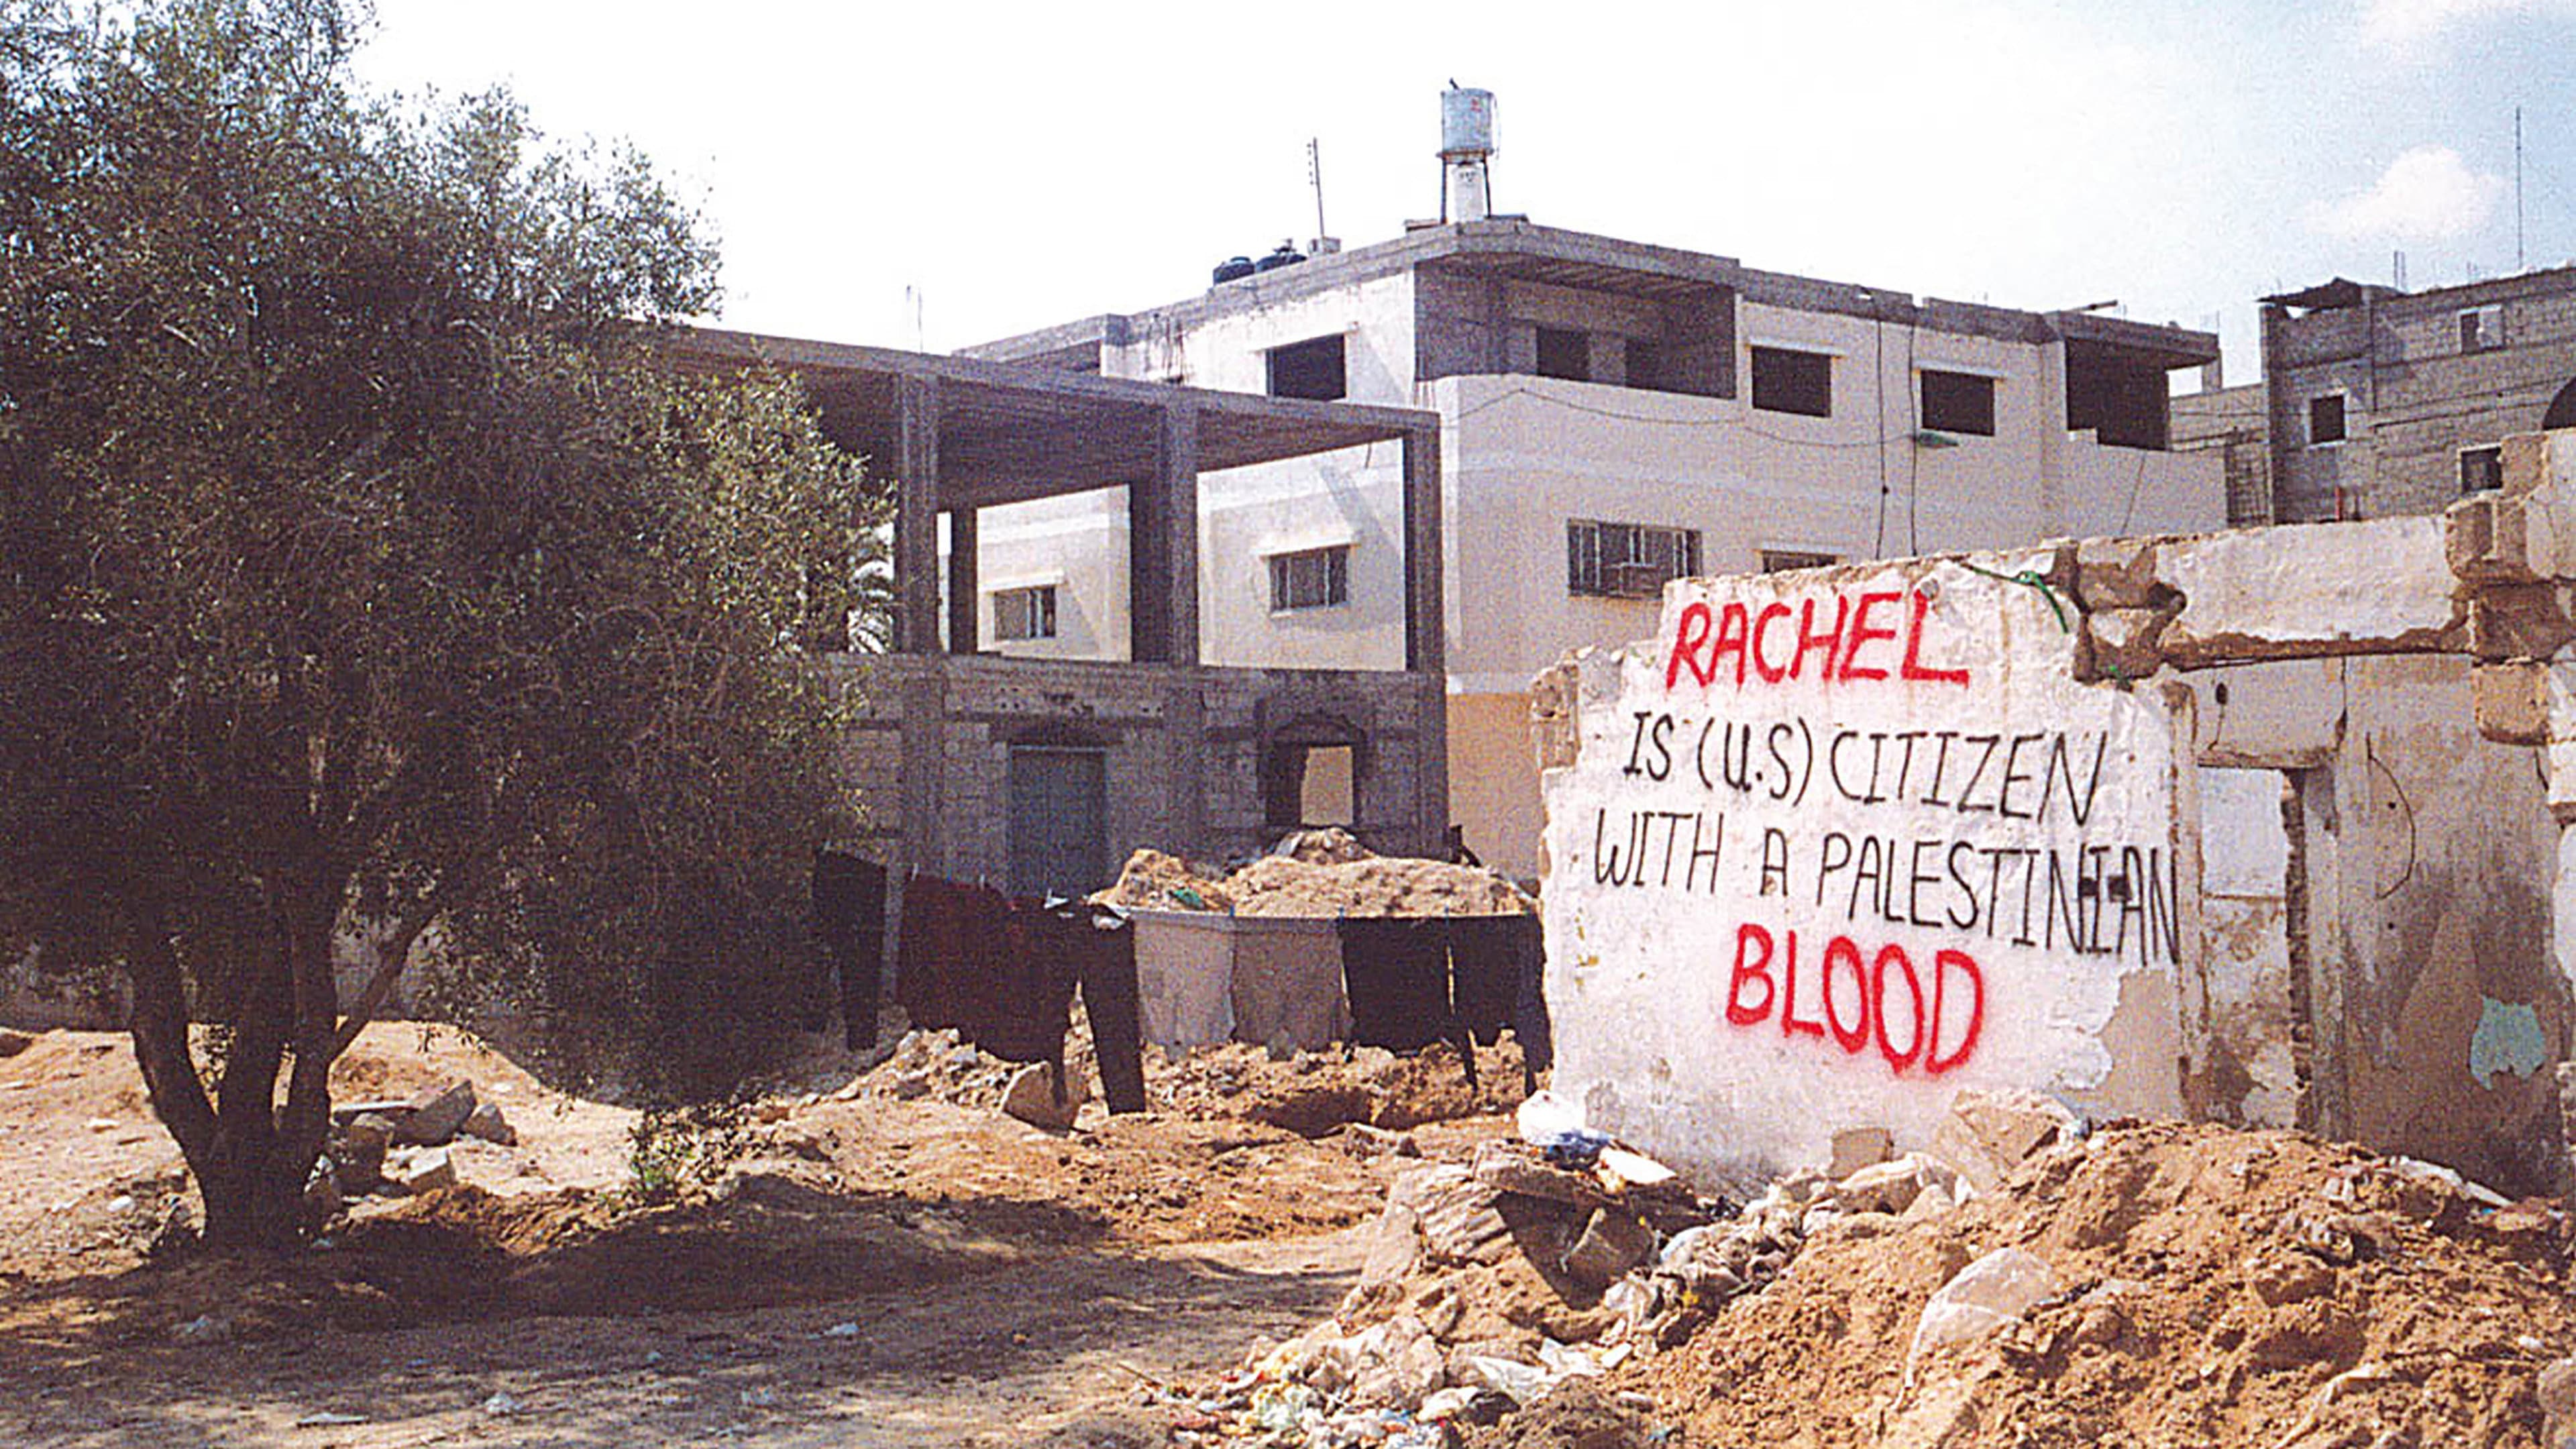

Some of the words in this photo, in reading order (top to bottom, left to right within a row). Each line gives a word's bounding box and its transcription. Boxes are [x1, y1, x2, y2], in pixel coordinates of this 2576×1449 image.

[1666, 590, 1970, 690] RACHEL
[1623, 711, 1674, 782] IS
[1830, 730, 2107, 826] CITIZEN
[1594, 808, 1724, 894] WITH
[1760, 828, 1789, 896] A
[1817, 833, 2180, 966] PALESTINIAN
[1726, 923, 1984, 1073] BLOOD
